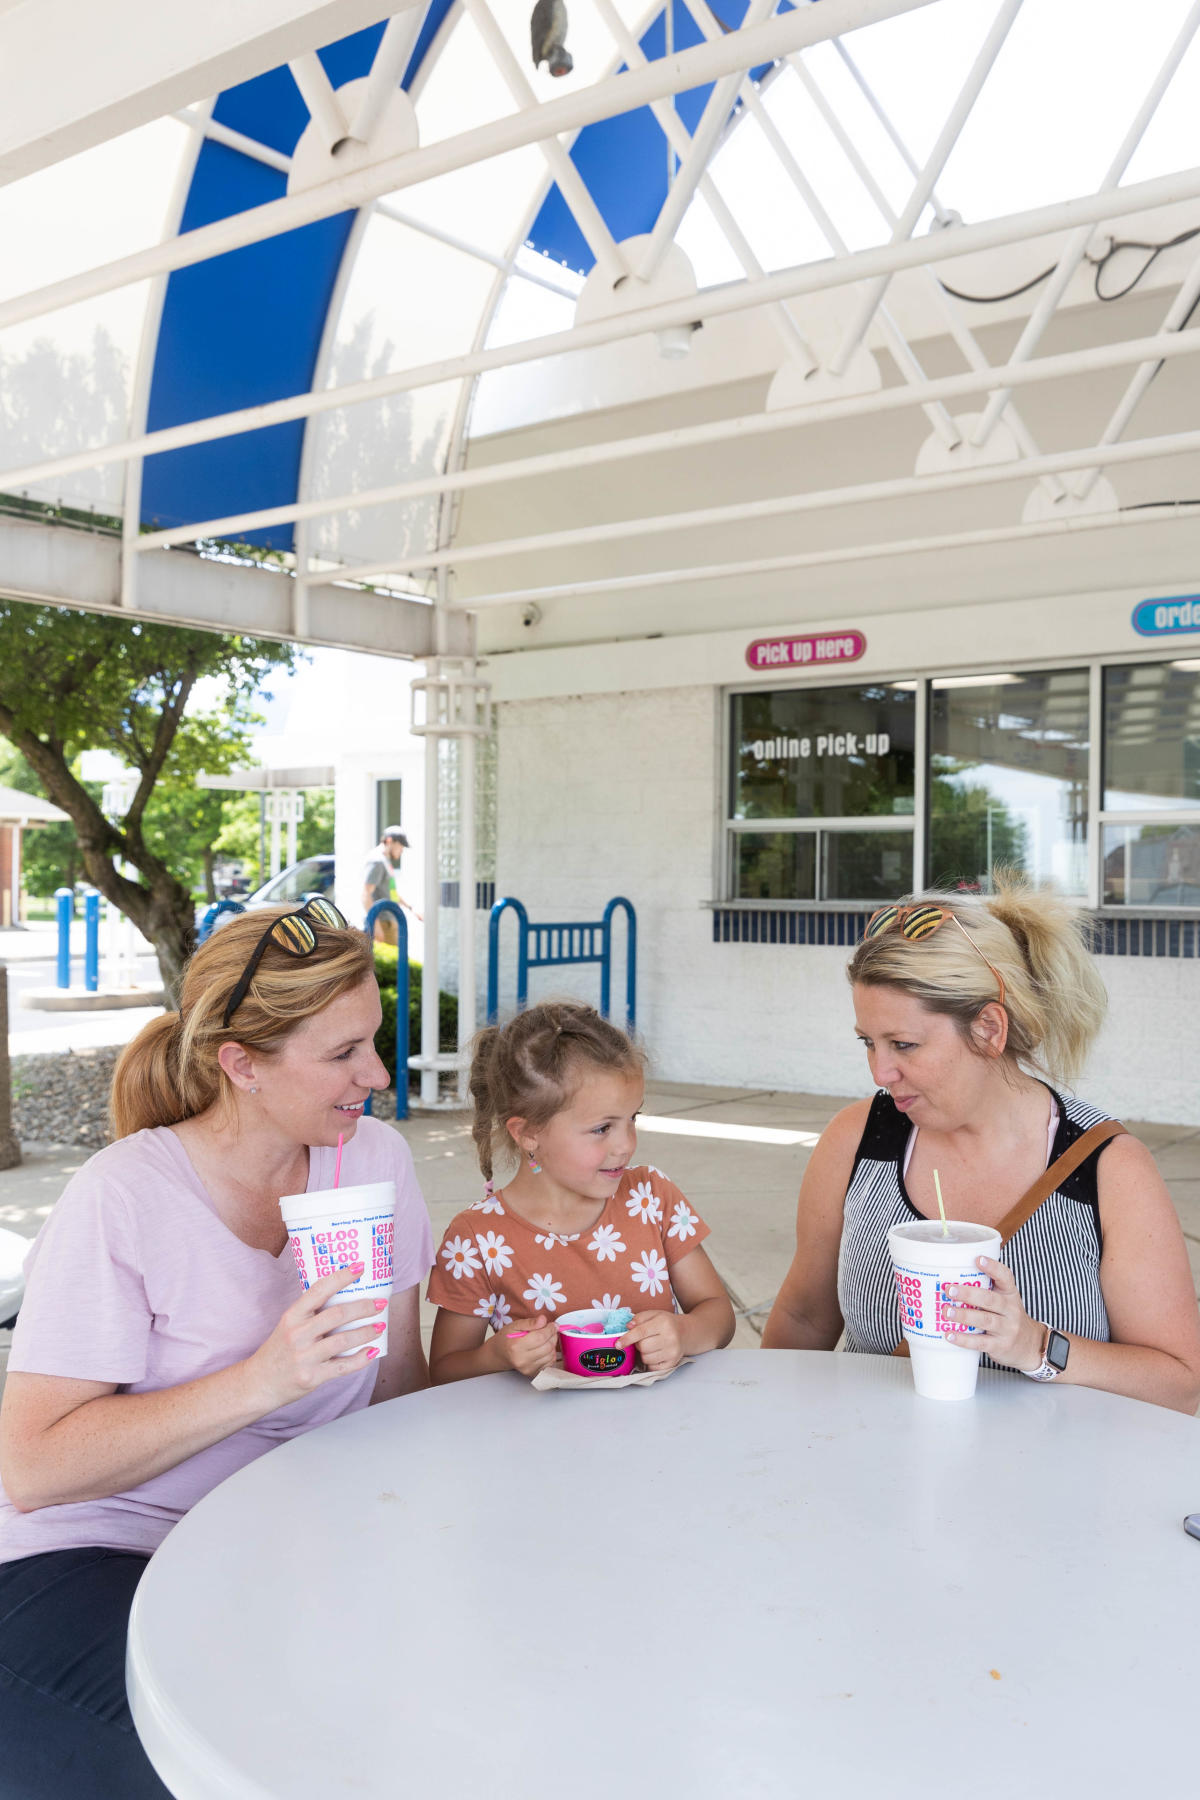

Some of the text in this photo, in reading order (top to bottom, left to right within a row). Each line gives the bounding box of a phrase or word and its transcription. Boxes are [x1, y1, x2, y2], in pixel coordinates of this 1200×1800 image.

[757, 637, 855, 665] Pick Up Here
[311, 1229, 358, 1244] IGLOO
[312, 1240, 359, 1255] IGLOO
[372, 1245, 393, 1258] IGLO
[314, 1251, 360, 1266] IGLOO
[596, 1354, 622, 1369] igloo
